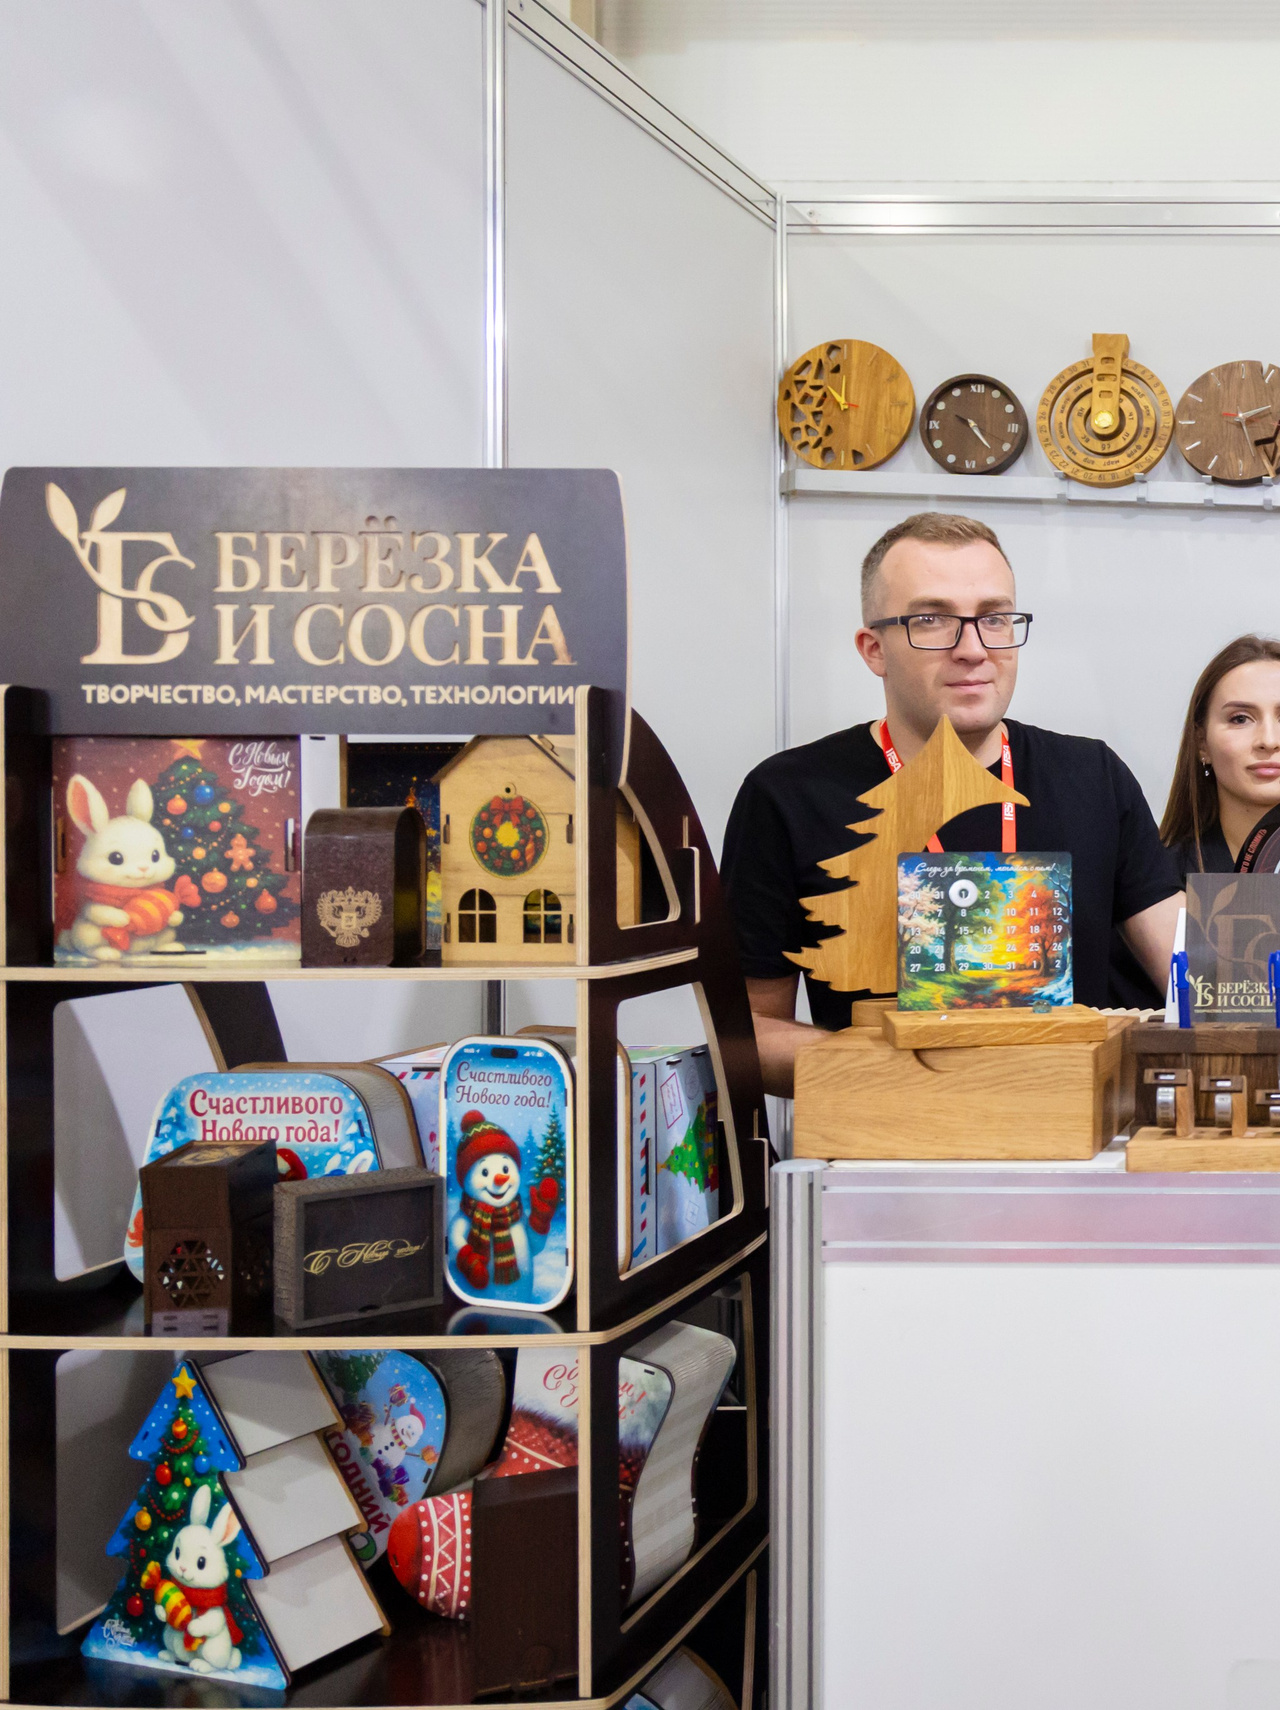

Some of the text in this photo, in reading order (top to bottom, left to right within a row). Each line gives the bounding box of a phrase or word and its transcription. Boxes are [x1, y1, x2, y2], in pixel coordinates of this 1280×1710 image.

[970, 384, 985, 393] XII
[1007, 424, 1018, 433] III
[213, 515, 562, 595] БЕРЁЗКА
[213, 603, 578, 666] И СОСНА
[81, 684, 576, 707] ТВОРЧЕСТВО, МАСТЕРСТВО, ТЕХНОЛОГИИ
[229, 741, 289, 773] С Новым
[910, 891, 921, 899] 30
[935, 891, 944, 899] 31
[985, 891, 989, 899] 2
[938, 909, 942, 917] 7
[911, 928, 920, 936] 13
[959, 927, 969, 935] 15
[910, 946, 921, 954] 20
[910, 964, 921, 972] 27
[1055, 960, 1060, 968] 2
[1217, 995, 1276, 1006] И СОСН
[457, 1061, 552, 1087] Счастливого
[189, 1089, 343, 1117] Счастливого
[456, 1085, 552, 1108] Нового года!
[201, 1120, 340, 1143] Нового года!
[326, 1431, 392, 1536] ГОДНИЙ
